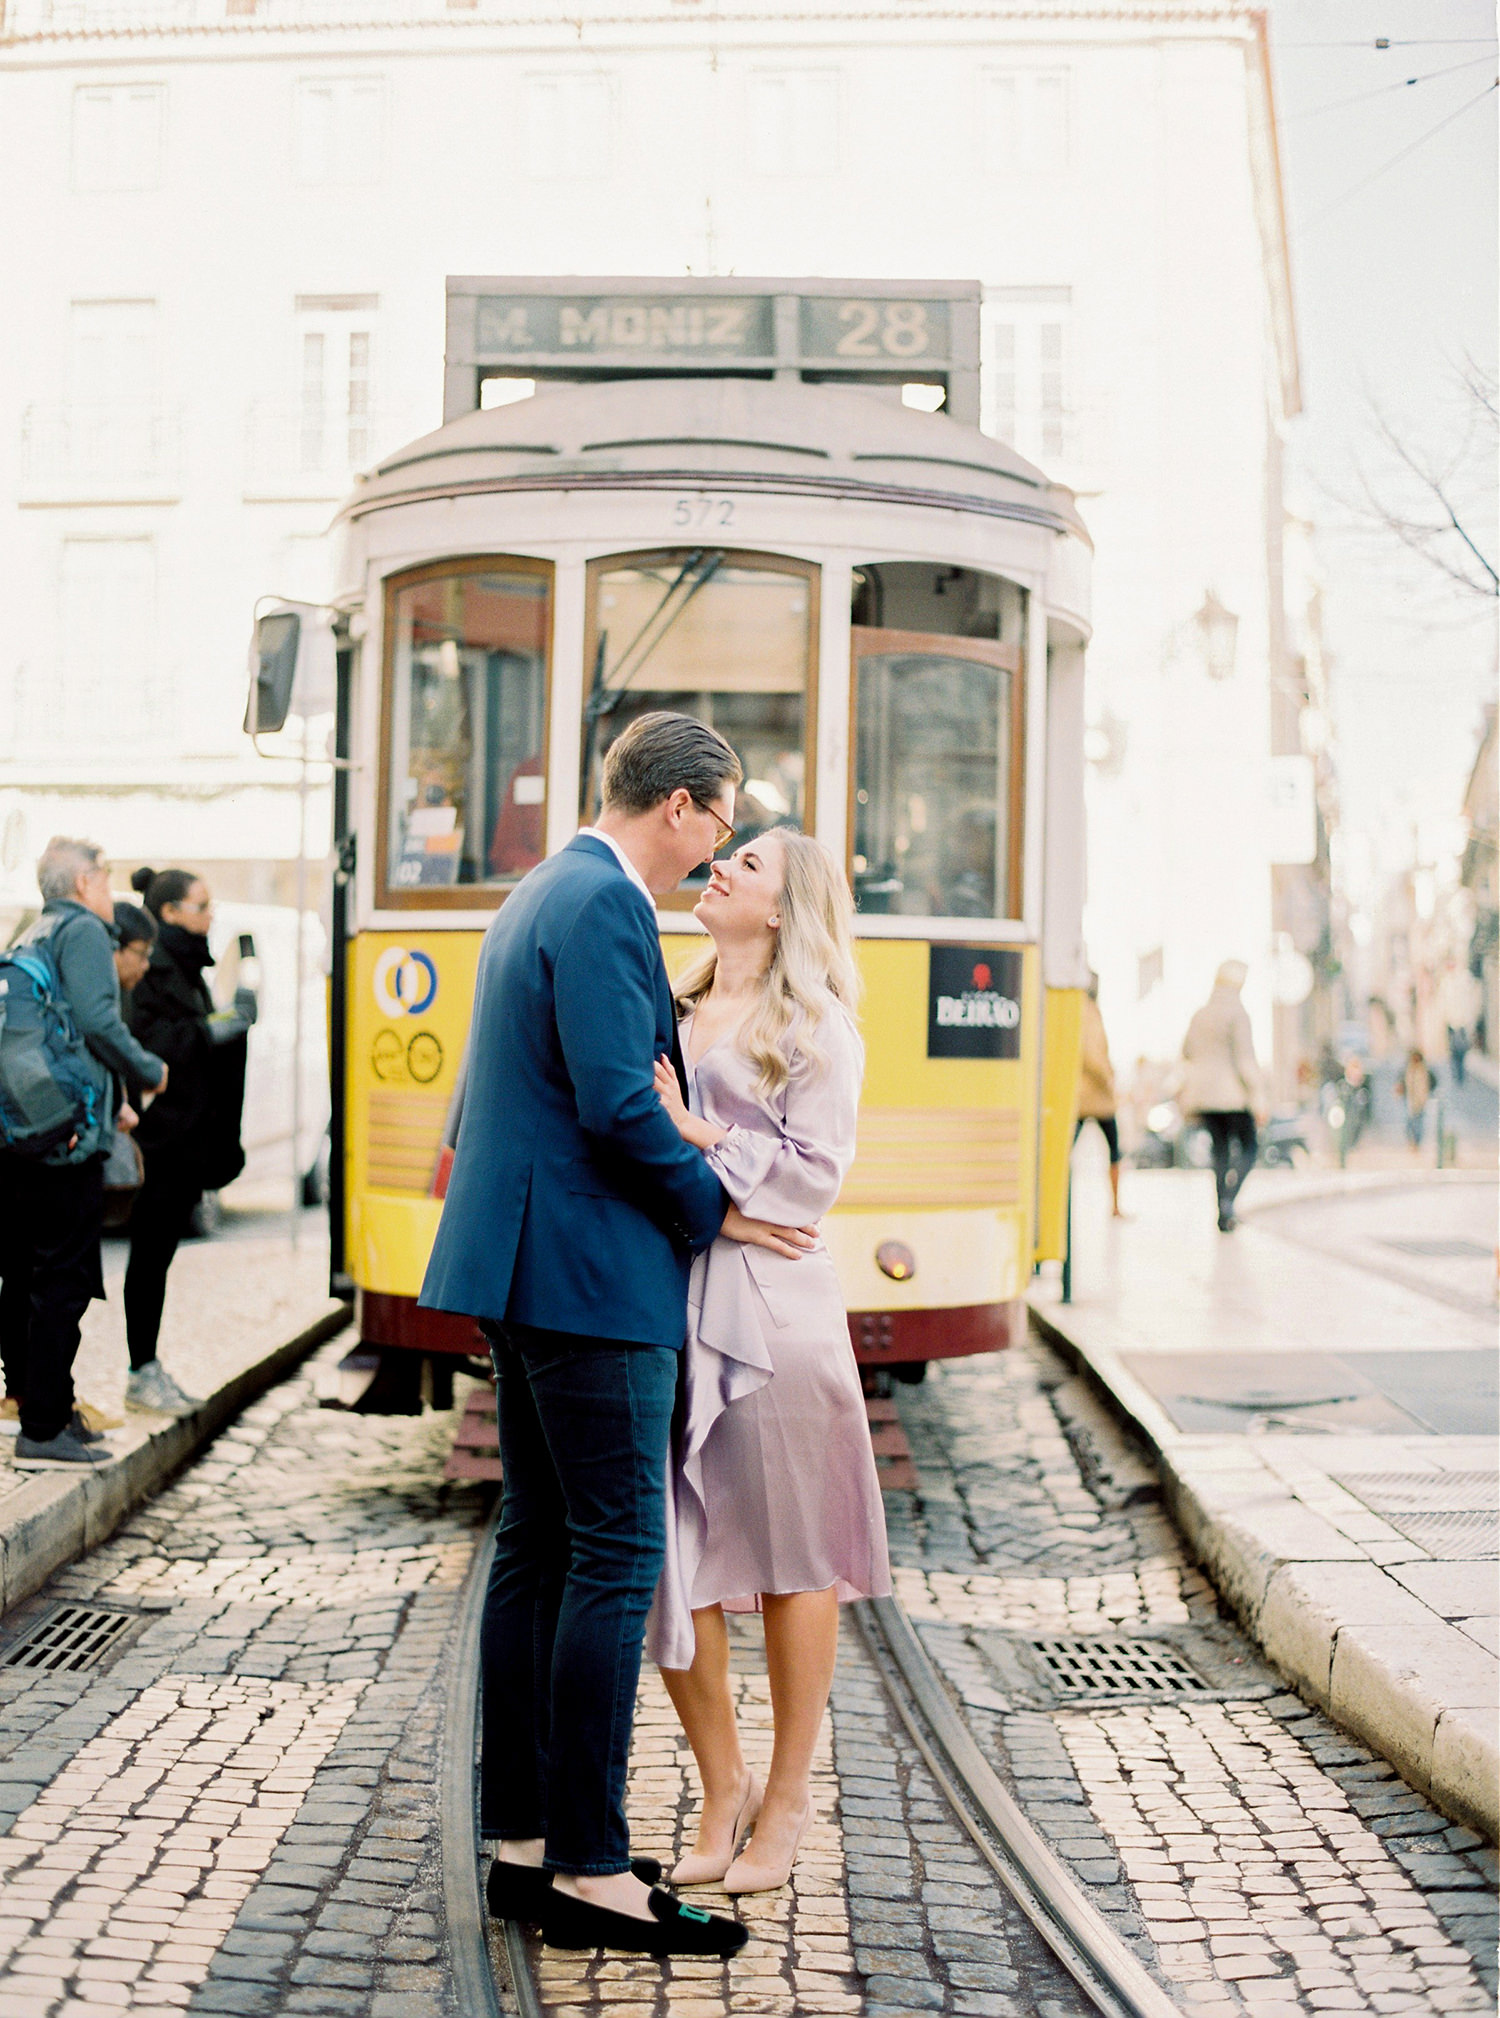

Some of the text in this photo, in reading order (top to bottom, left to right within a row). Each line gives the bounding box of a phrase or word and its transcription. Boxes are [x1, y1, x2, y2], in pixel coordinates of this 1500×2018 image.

[558, 307, 746, 346] MONIZ
[836, 302, 930, 358] 28
[674, 499, 735, 526] 572
